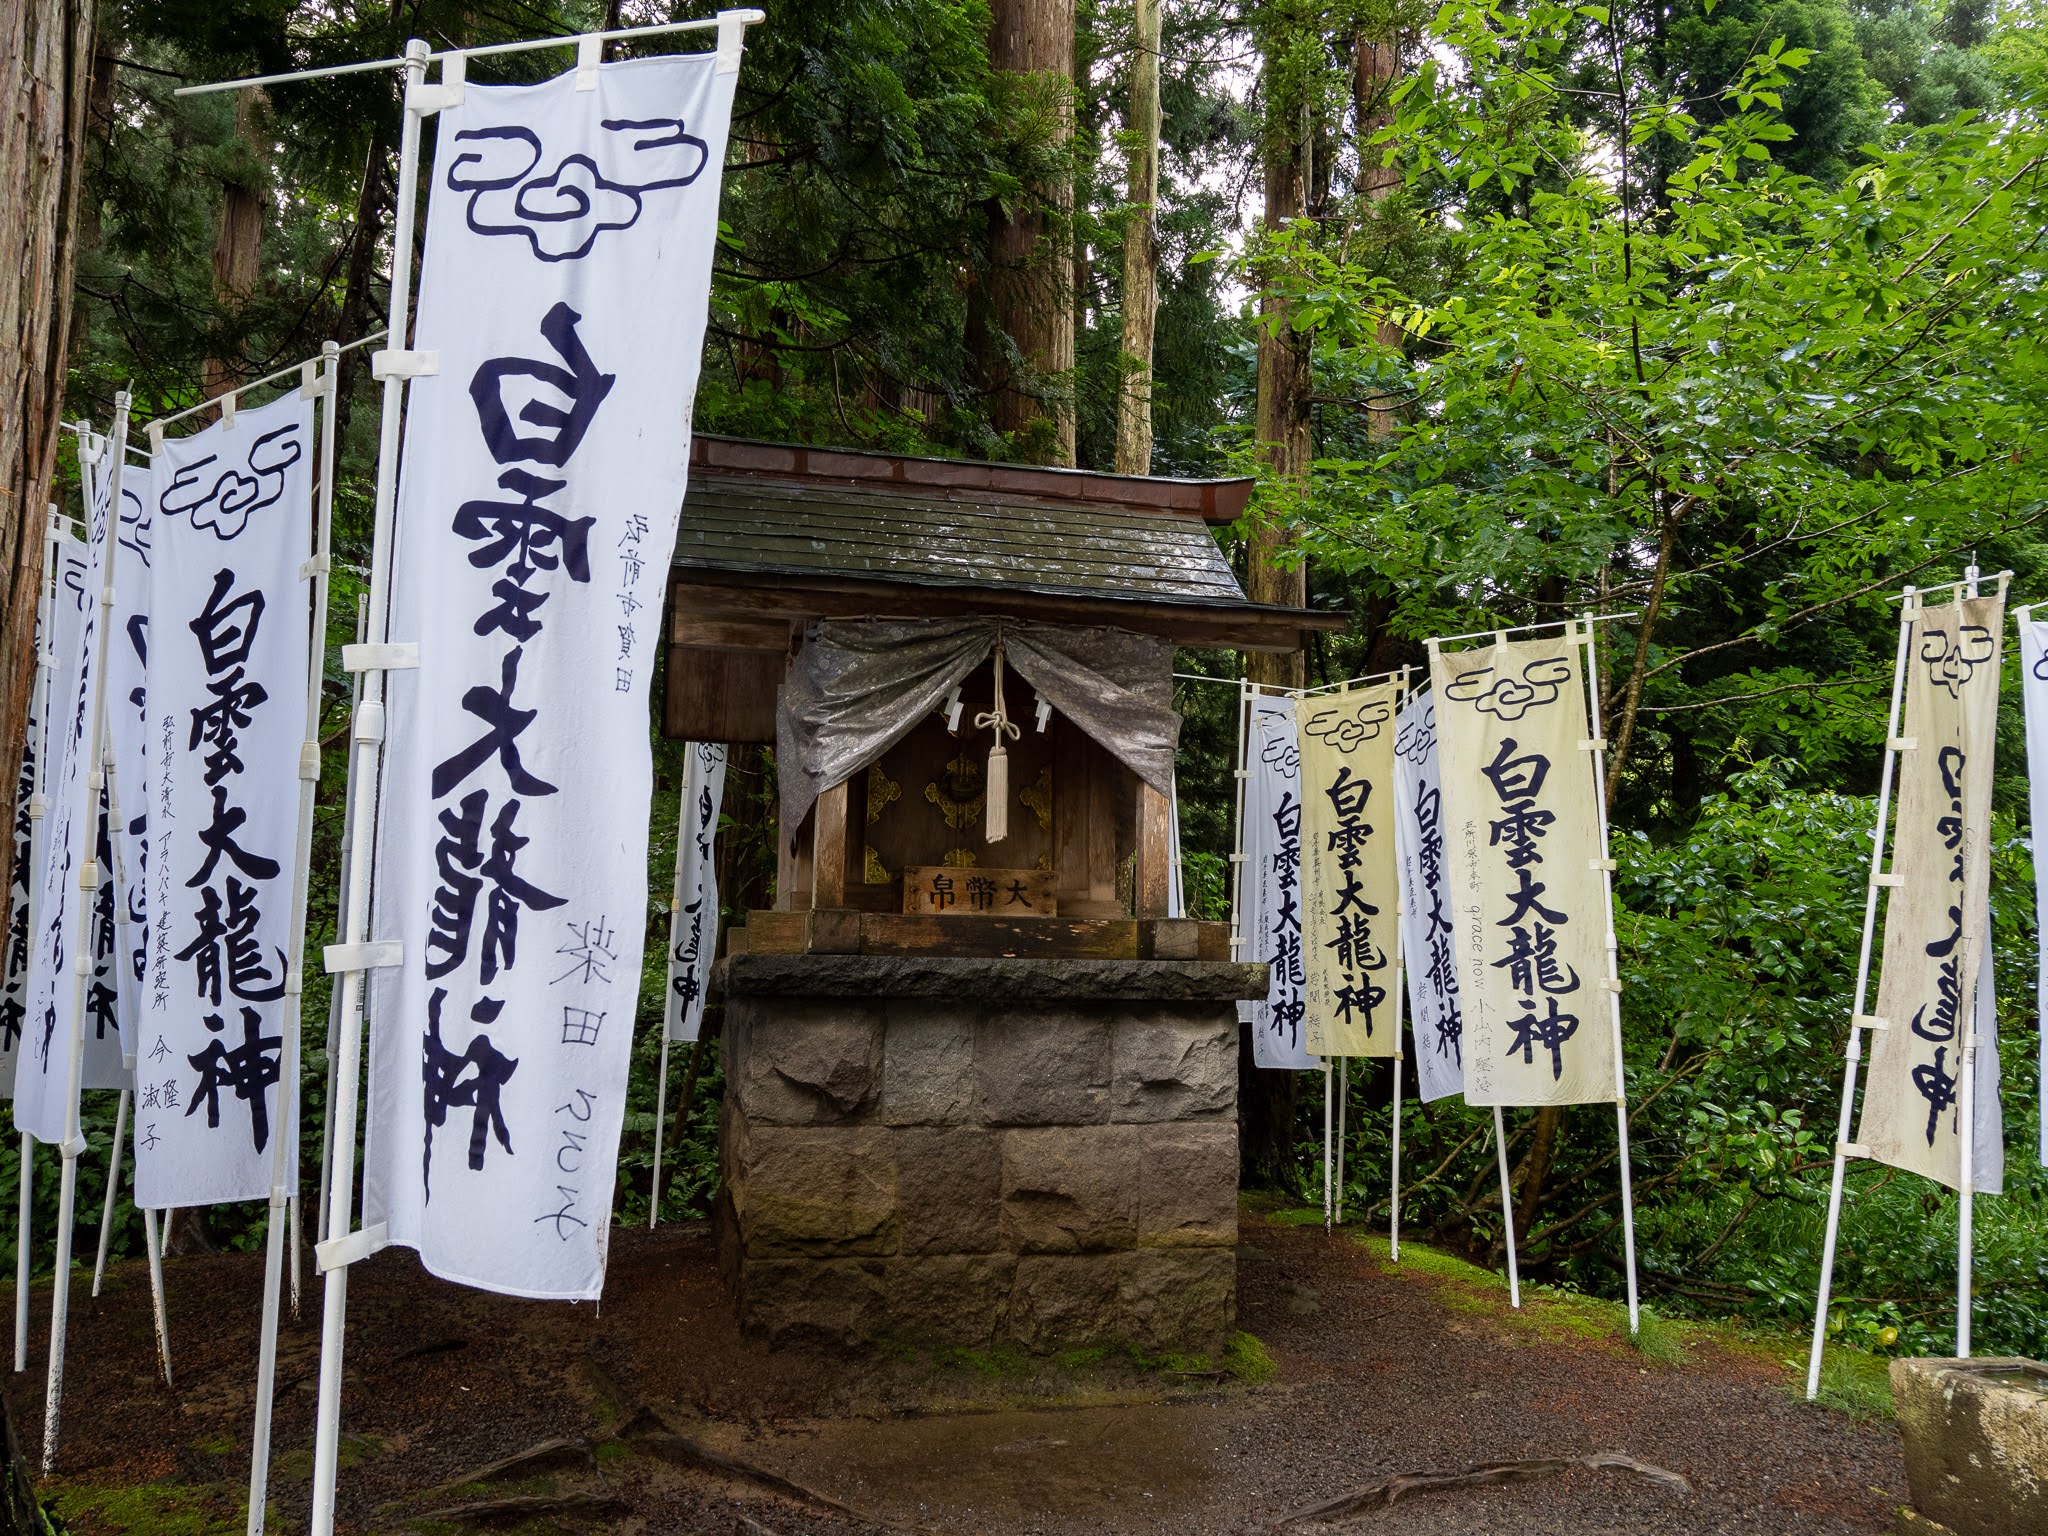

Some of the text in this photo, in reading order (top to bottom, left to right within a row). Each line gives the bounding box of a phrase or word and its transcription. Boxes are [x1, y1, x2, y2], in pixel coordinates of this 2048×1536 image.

[174, 567, 288, 1155] 白雲大龍神
[1269, 792, 1306, 1050] 白雲大龍神
[1324, 767, 1387, 1039] 白雲大龍神
[1414, 779, 1463, 1071] 白雲大龍神
[1481, 738, 1580, 1082] 白雲大龍神
